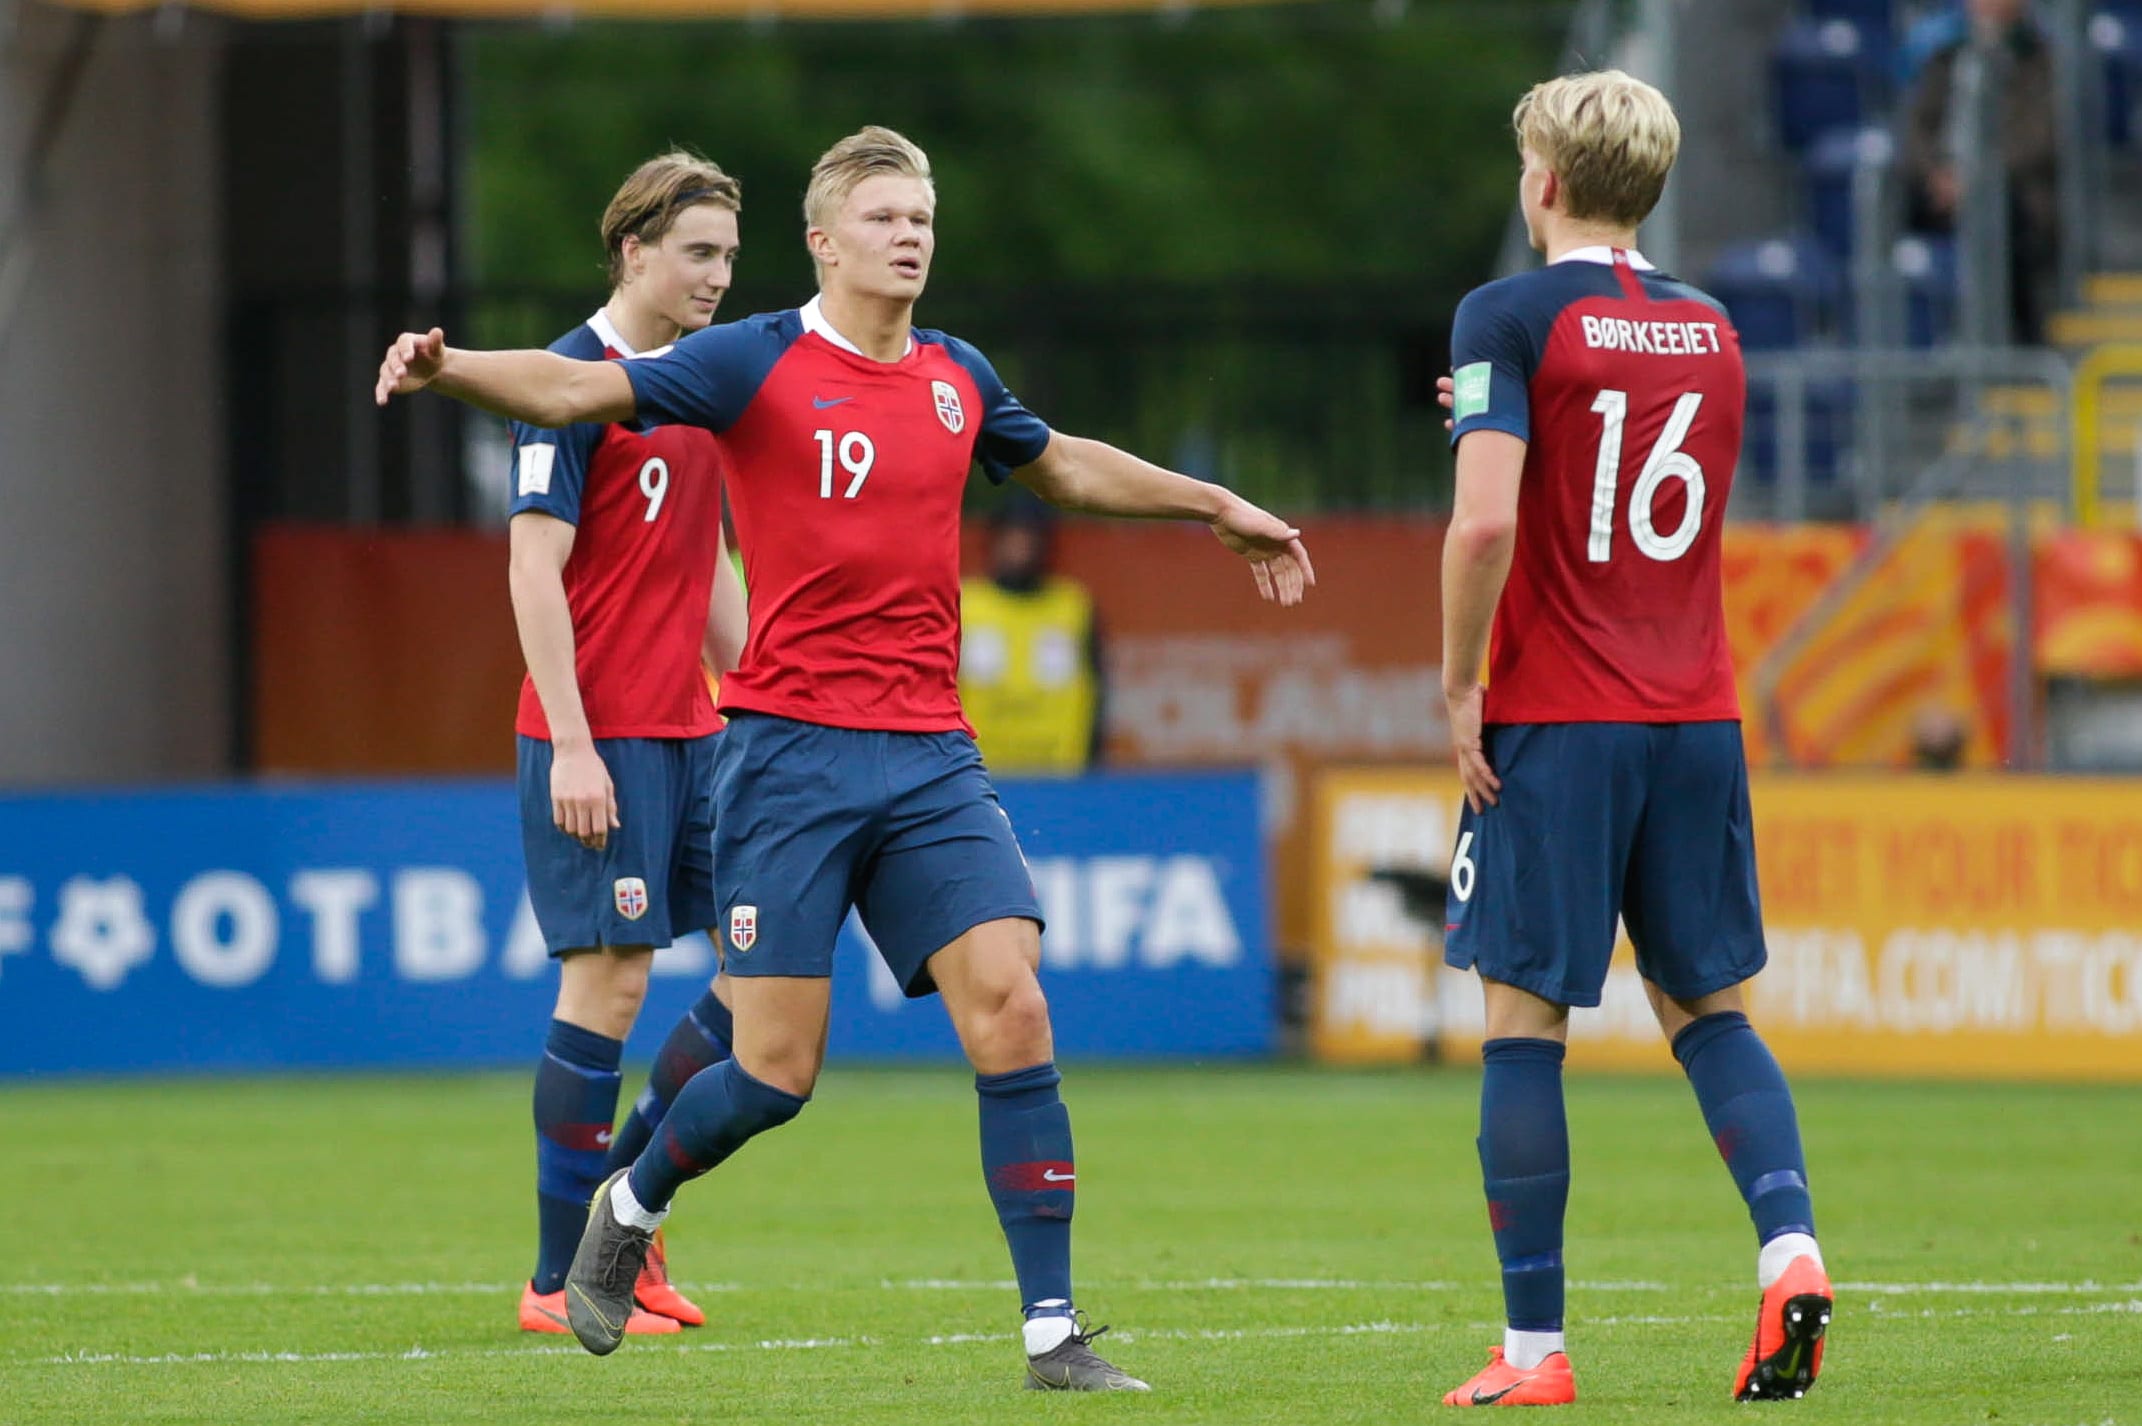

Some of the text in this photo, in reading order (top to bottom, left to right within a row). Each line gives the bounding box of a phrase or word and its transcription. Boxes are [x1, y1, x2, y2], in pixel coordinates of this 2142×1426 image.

[1580, 314, 1721, 355] BØRKEEIET
[638, 455, 669, 523] 9
[813, 428, 876, 499] 19
[1589, 388, 1706, 563] 16
[1450, 831, 1476, 903] 6
